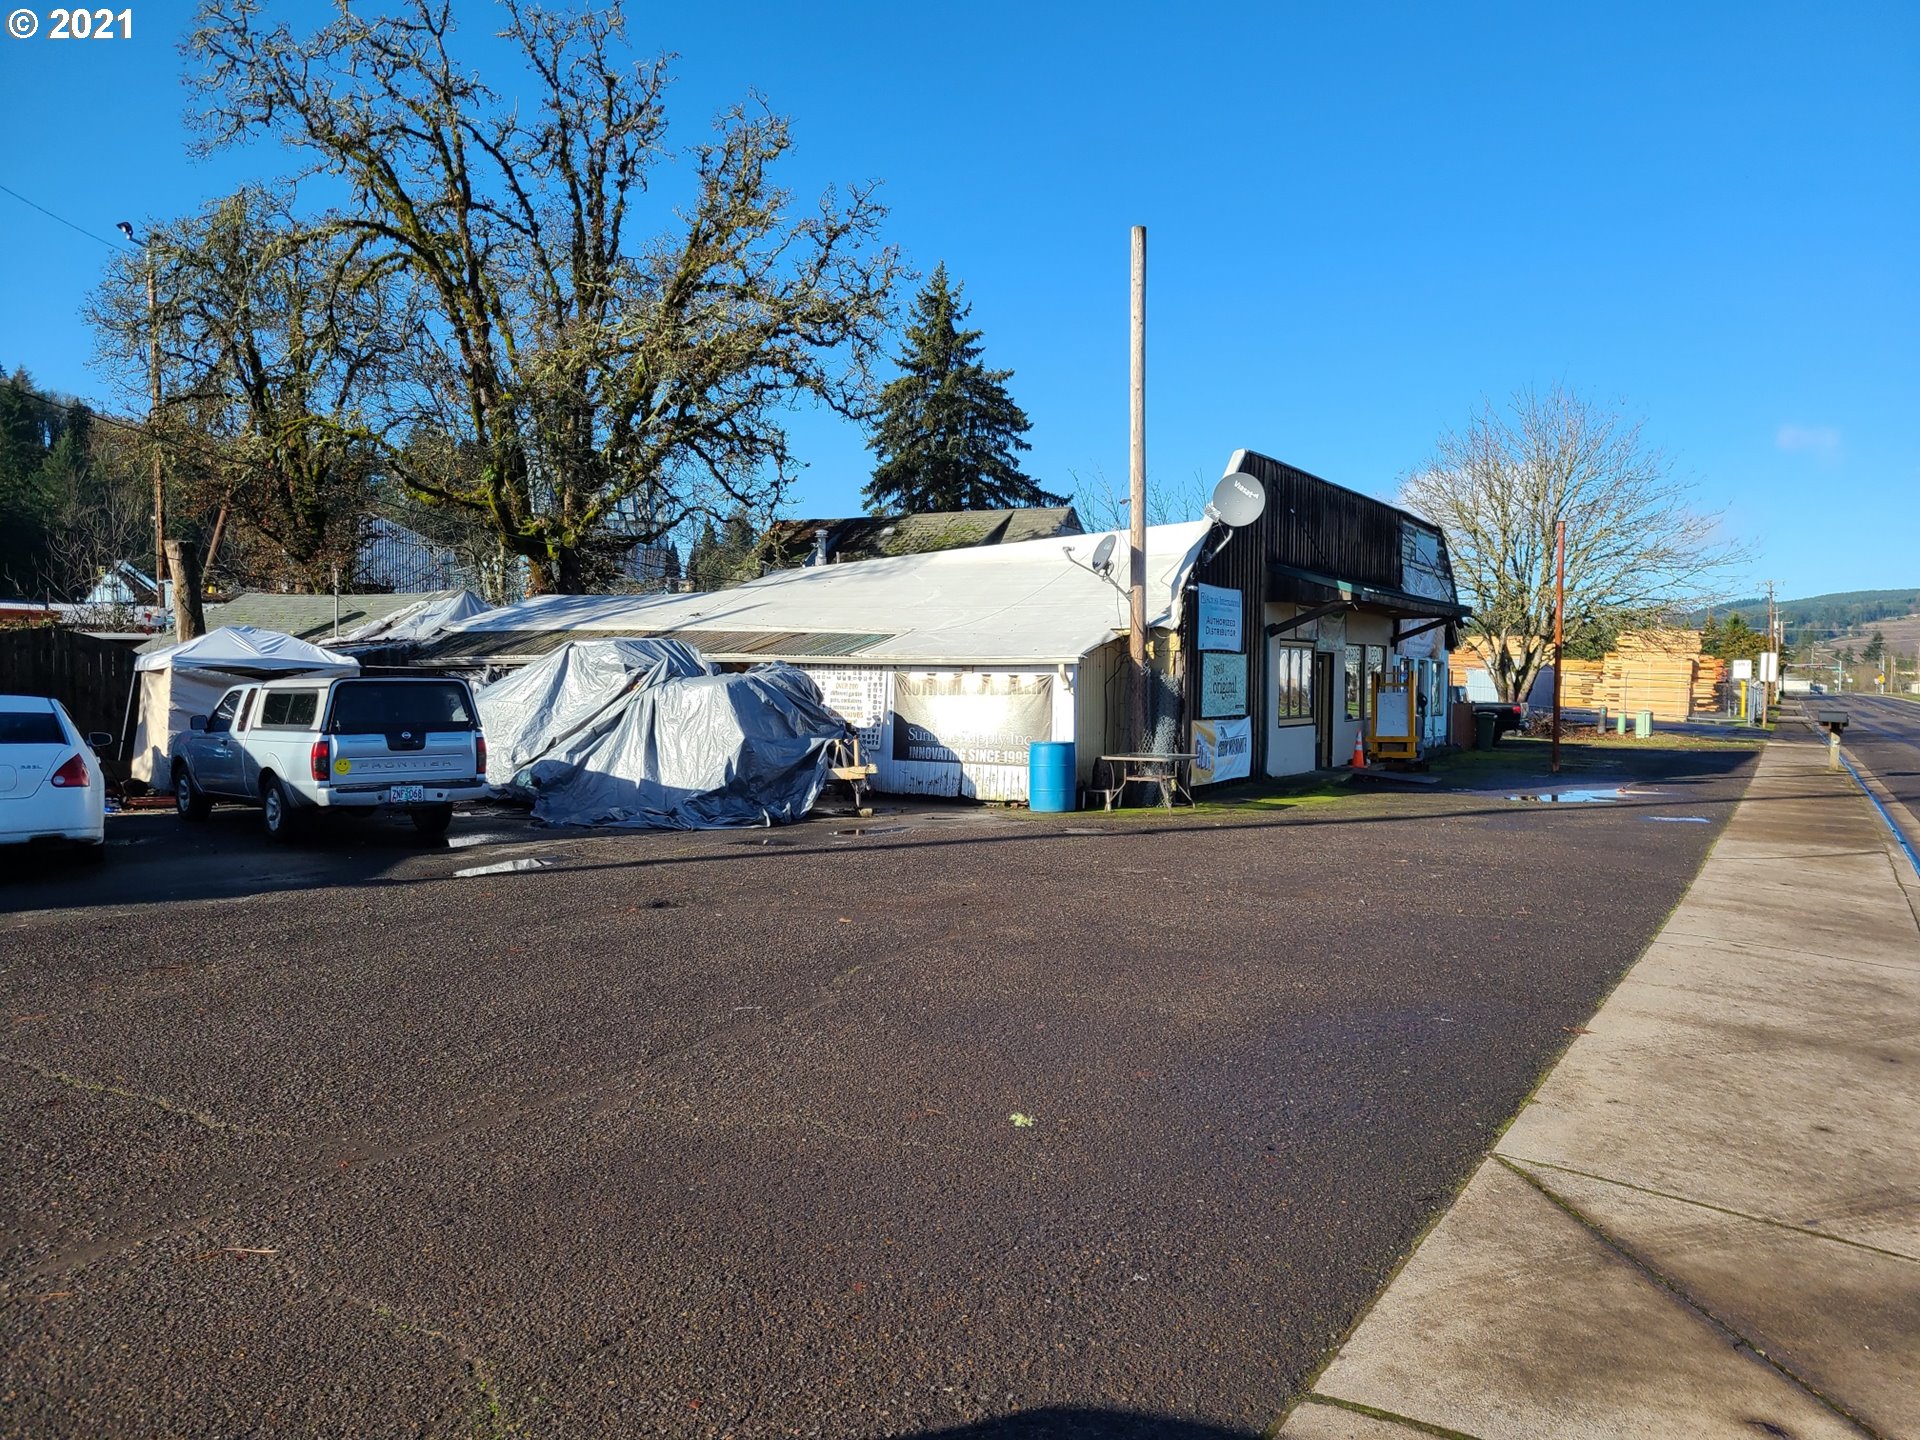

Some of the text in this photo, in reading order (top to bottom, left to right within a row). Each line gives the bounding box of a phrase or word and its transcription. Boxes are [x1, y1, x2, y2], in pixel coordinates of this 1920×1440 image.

[1234, 480, 1259, 499] Viasat
[1206, 616, 1236, 627] AUTHORIZED
[1205, 625, 1236, 637] DISTRIBUTOR
[909, 745, 966, 761] INNOVATING
[968, 747, 1001, 763] SINCE
[360, 761, 452, 769] FRONTIER
